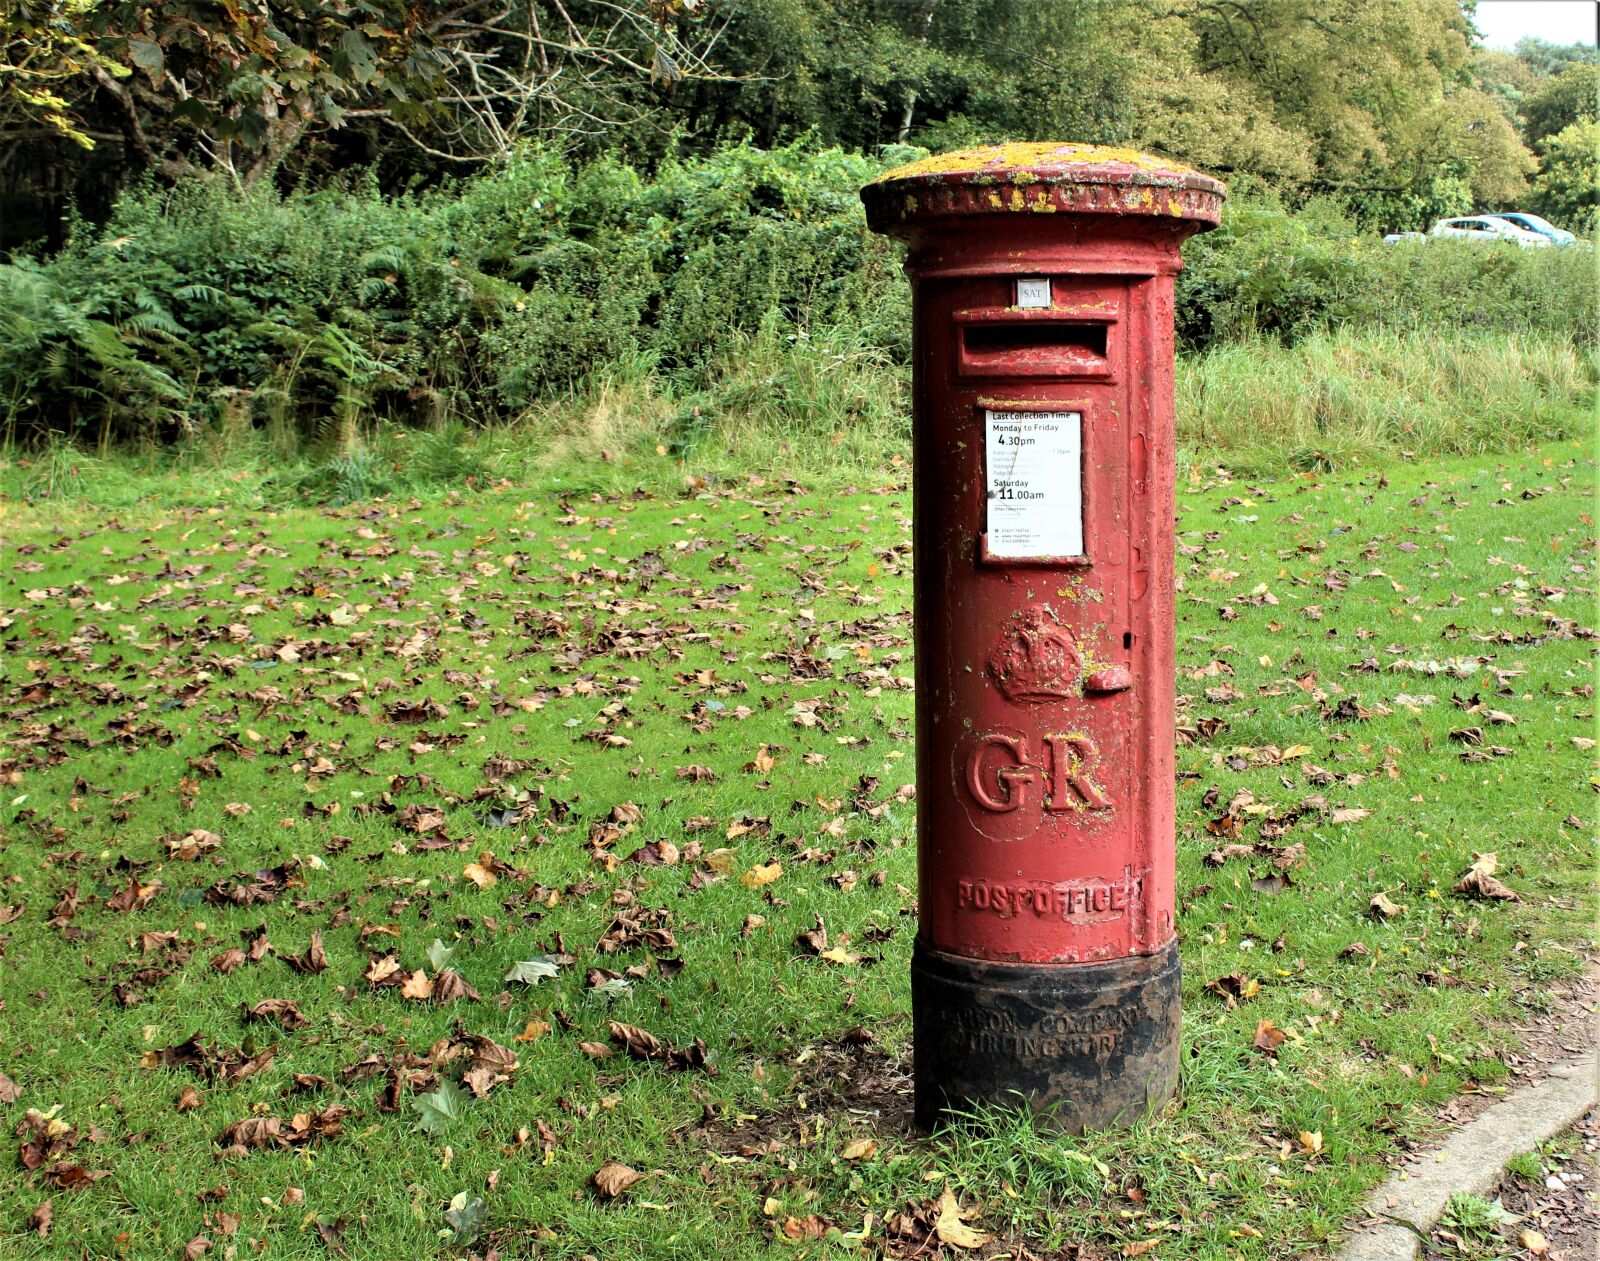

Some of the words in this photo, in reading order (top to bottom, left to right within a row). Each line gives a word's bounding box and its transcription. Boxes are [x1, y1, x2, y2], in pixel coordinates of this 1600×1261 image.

[1024, 289, 1042, 298] SAT
[992, 412, 1008, 420] Last
[1010, 412, 1048, 420] Collection
[993, 425, 1021, 433] Monday
[1024, 424, 1032, 432] to
[1034, 424, 1058, 432] Friday
[998, 434, 1035, 446] 4.30pm
[994, 480, 1028, 488] Saturday
[999, 489, 1044, 500] 11.00am
[966, 732, 1114, 812] GR
[958, 880, 1026, 914] POST
[1032, 884, 1126, 914] OFFICE
